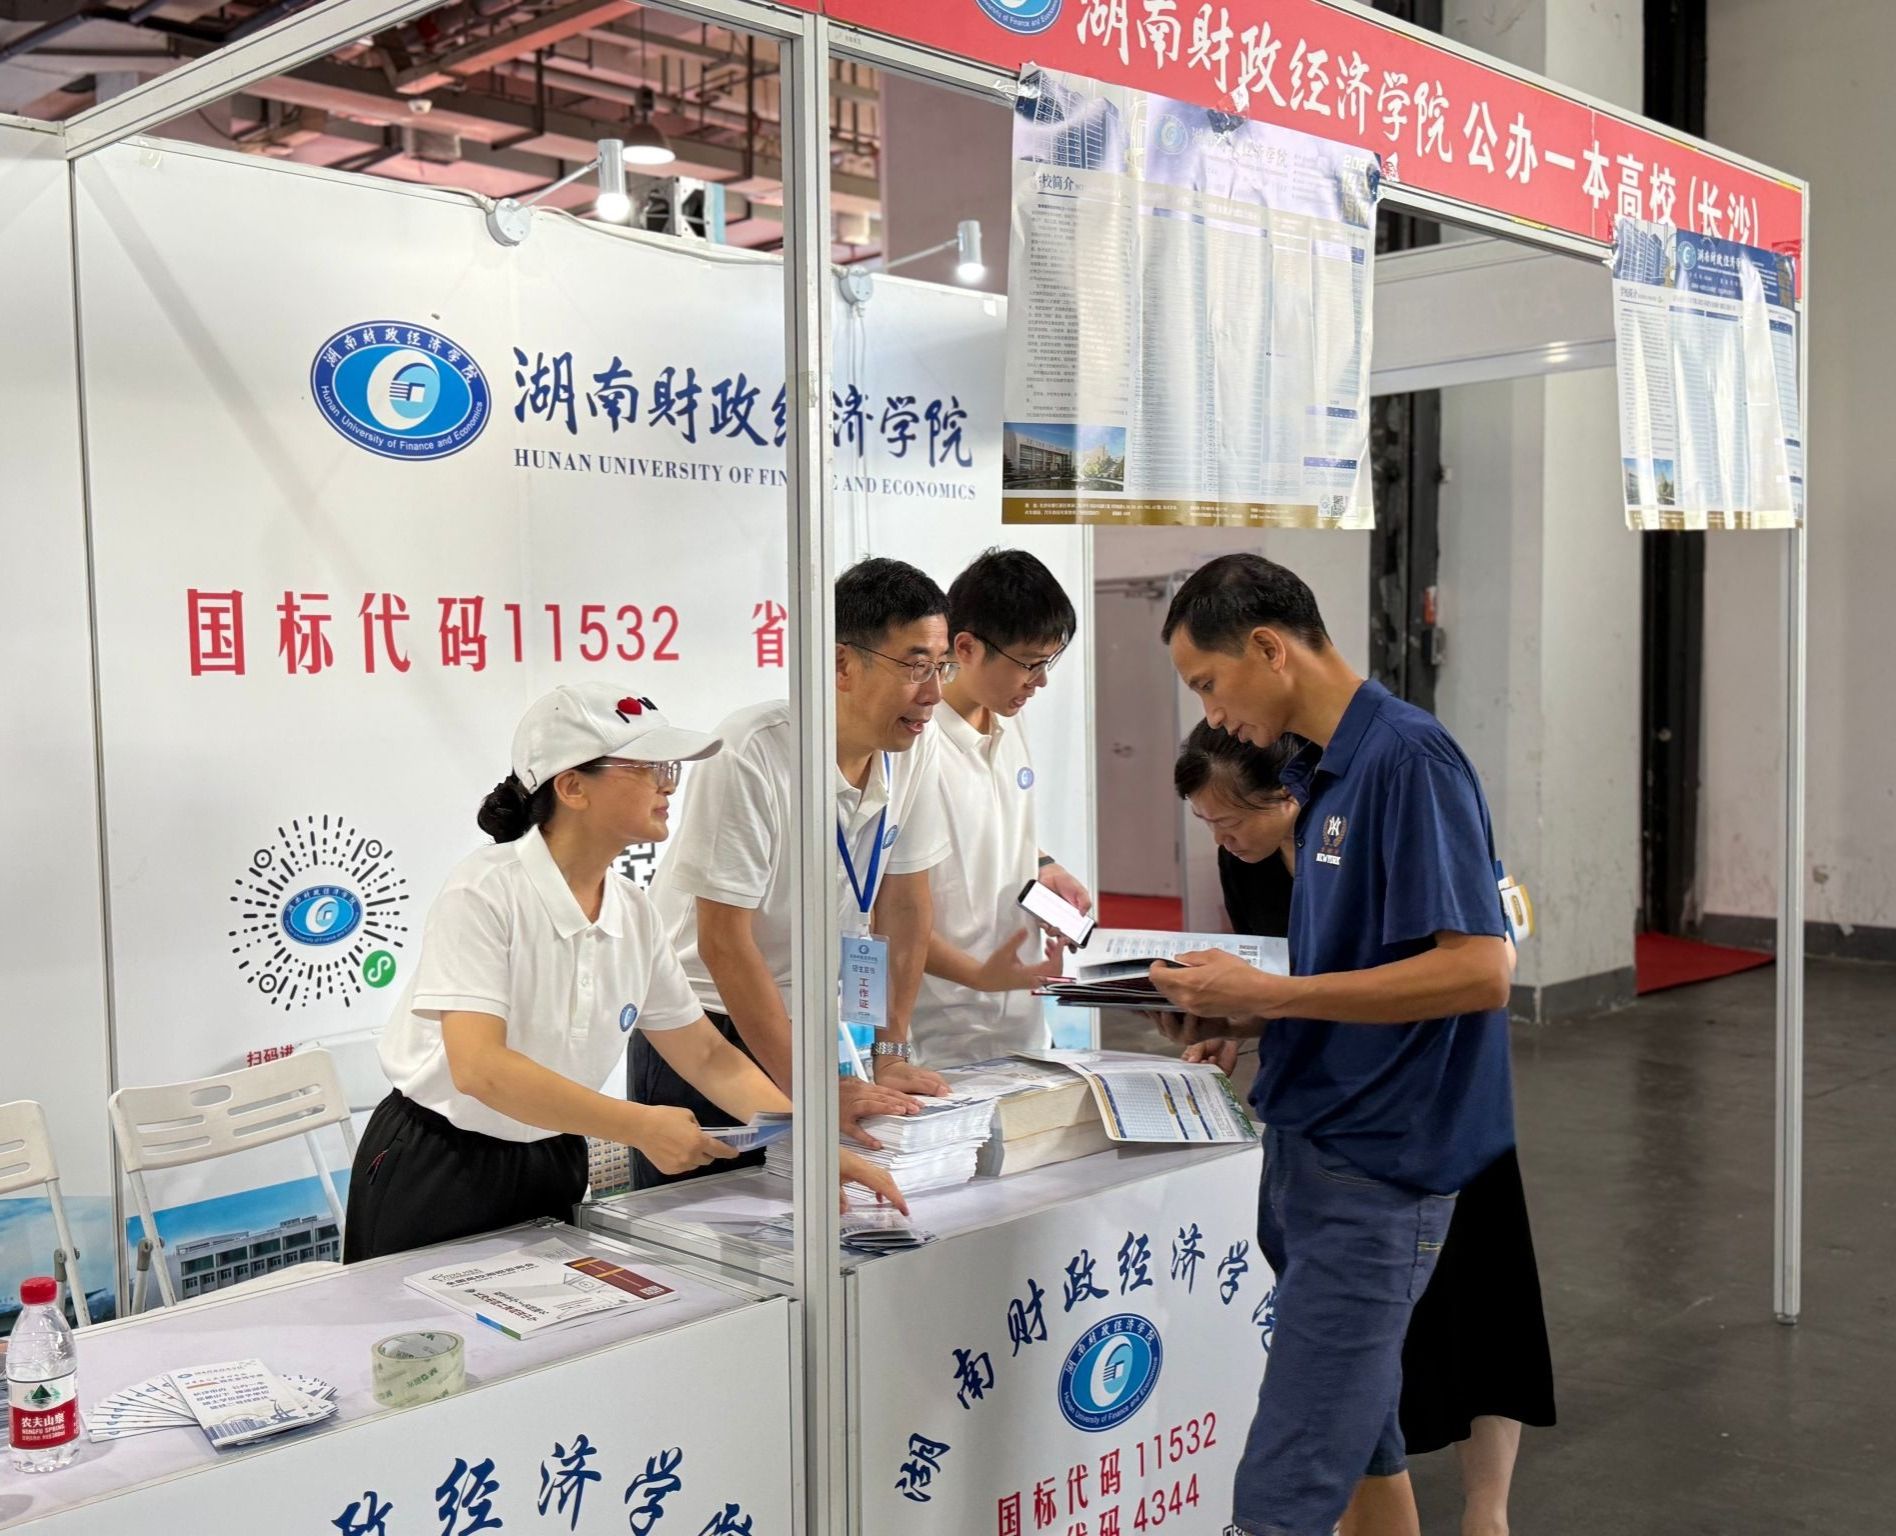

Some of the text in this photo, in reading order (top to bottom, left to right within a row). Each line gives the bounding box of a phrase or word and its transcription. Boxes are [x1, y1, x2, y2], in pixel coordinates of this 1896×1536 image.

[321, 385, 483, 451] Hunan University of Finance and Economics
[513, 448, 592, 472] HUNAN
[598, 456, 727, 483] UNIVERSITY
[729, 466, 754, 485] OF
[842, 474, 878, 494] AND
[881, 479, 977, 501] ECONOMICS
